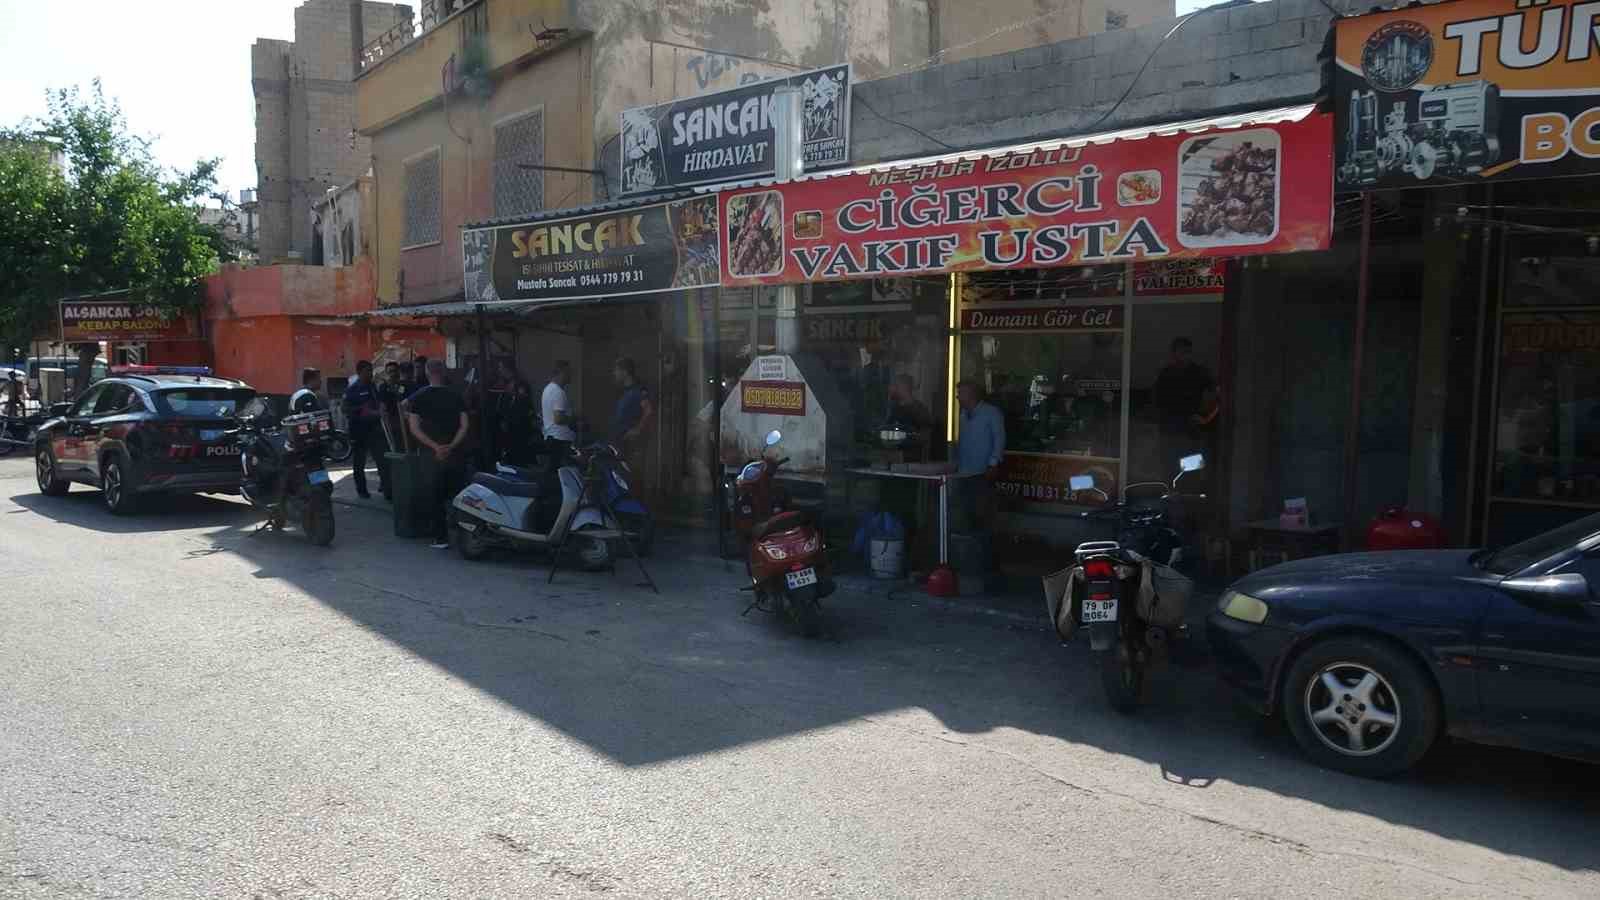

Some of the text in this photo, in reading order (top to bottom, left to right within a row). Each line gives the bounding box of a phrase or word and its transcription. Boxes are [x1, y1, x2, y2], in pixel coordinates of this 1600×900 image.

[672, 94, 776, 147] SANCAK
[683, 142, 769, 172] HİRDAVAT
[868, 161, 976, 187] MEŞHUR
[837, 164, 1102, 234] CİĞERCİ
[512, 214, 645, 259] SANCAK
[790, 217, 1169, 279] VAKIF USTA
[516, 279, 547, 290] Mustafa
[549, 277, 577, 288] Sancak
[603, 271, 618, 284] 779
[621, 270, 631, 282] 79
[633, 269, 644, 281] 31
[64, 307, 130, 320] ALSANCAK
[79, 319, 170, 331] KEBAP SALONU
[970, 307, 1113, 328] Dumanı Gör Gel
[1085, 602, 1097, 610] 79
